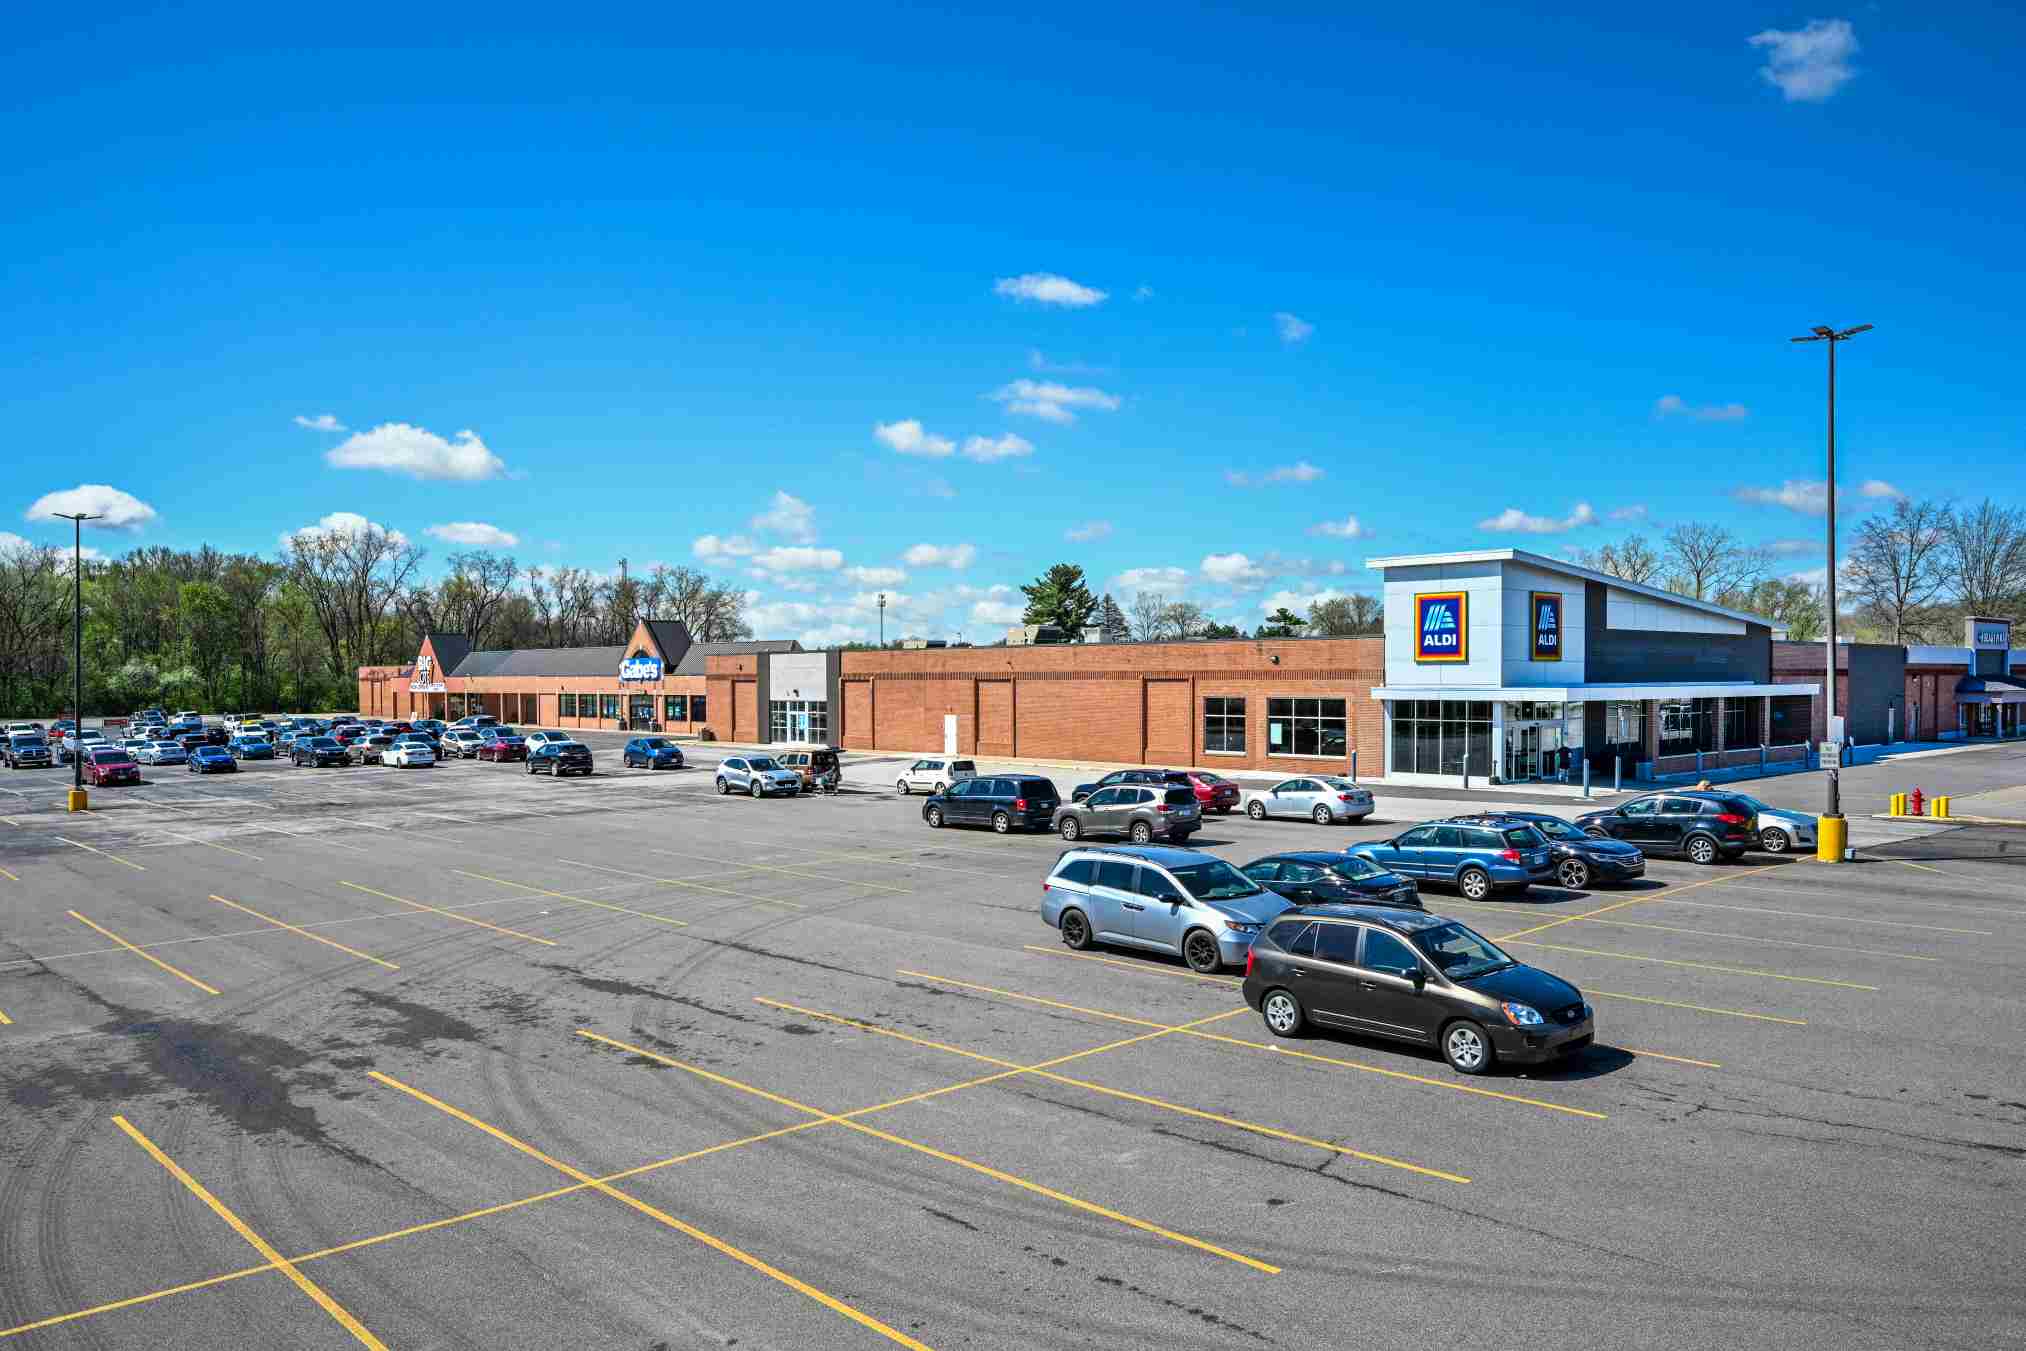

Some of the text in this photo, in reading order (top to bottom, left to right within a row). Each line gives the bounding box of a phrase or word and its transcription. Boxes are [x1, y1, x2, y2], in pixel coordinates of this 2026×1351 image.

[1424, 634, 1457, 646] ALDI
[1538, 634, 1557, 646] ALDI
[621, 659, 658, 678] Gabe's
